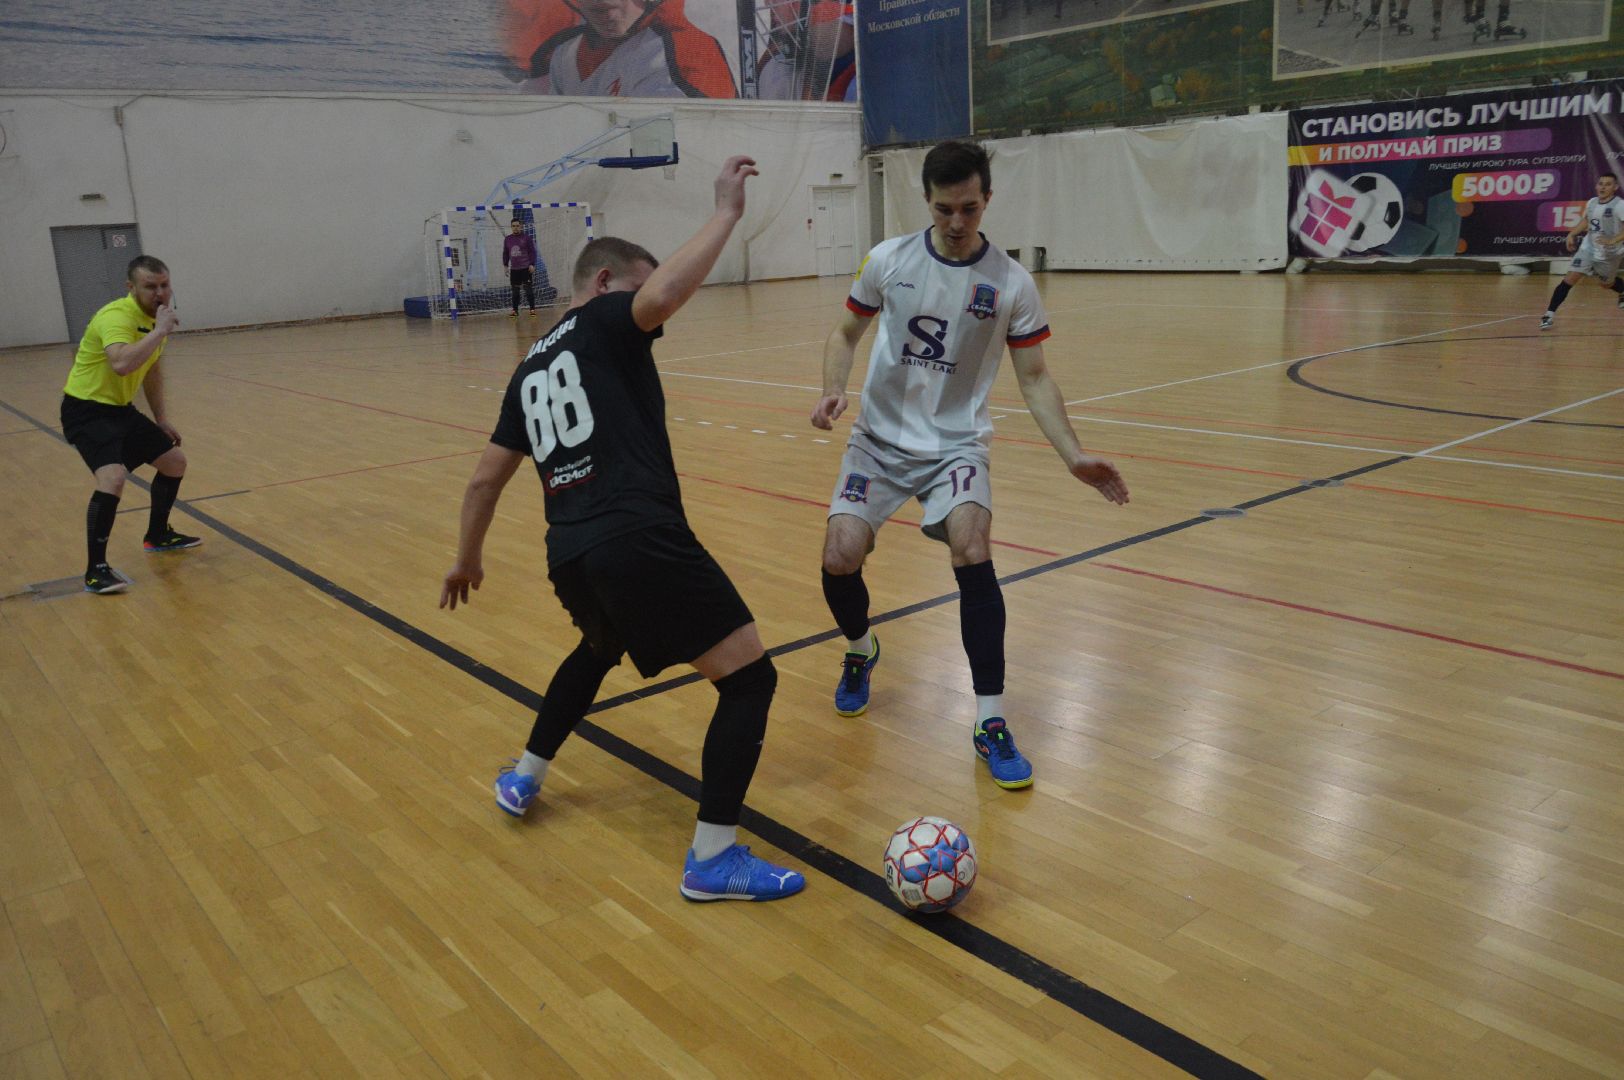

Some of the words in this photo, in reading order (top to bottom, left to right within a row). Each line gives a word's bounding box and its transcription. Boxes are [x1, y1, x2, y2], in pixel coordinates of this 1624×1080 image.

[867, 13, 922, 33] Московской
[923, 7, 960, 22] области
[1302, 107, 1461, 138] СТАНОВИСЬ
[1467, 92, 1610, 126] ЛУЧШИМ
[1319, 147, 1332, 161] И
[1337, 135, 1438, 160] ПОЛУЧАЙ
[1443, 135, 1502, 154] ПРИЗ
[1428, 161, 1471, 171] ЛУЧШЕМУ
[1472, 159, 1505, 168] ИГРОКУ
[1508, 158, 1529, 166] ТУРА
[1532, 154, 1587, 166] СУПЕРЛИГИ
[900, 357, 930, 369] SAINT
[521, 350, 594, 463] 88
[949, 465, 976, 498] 17
